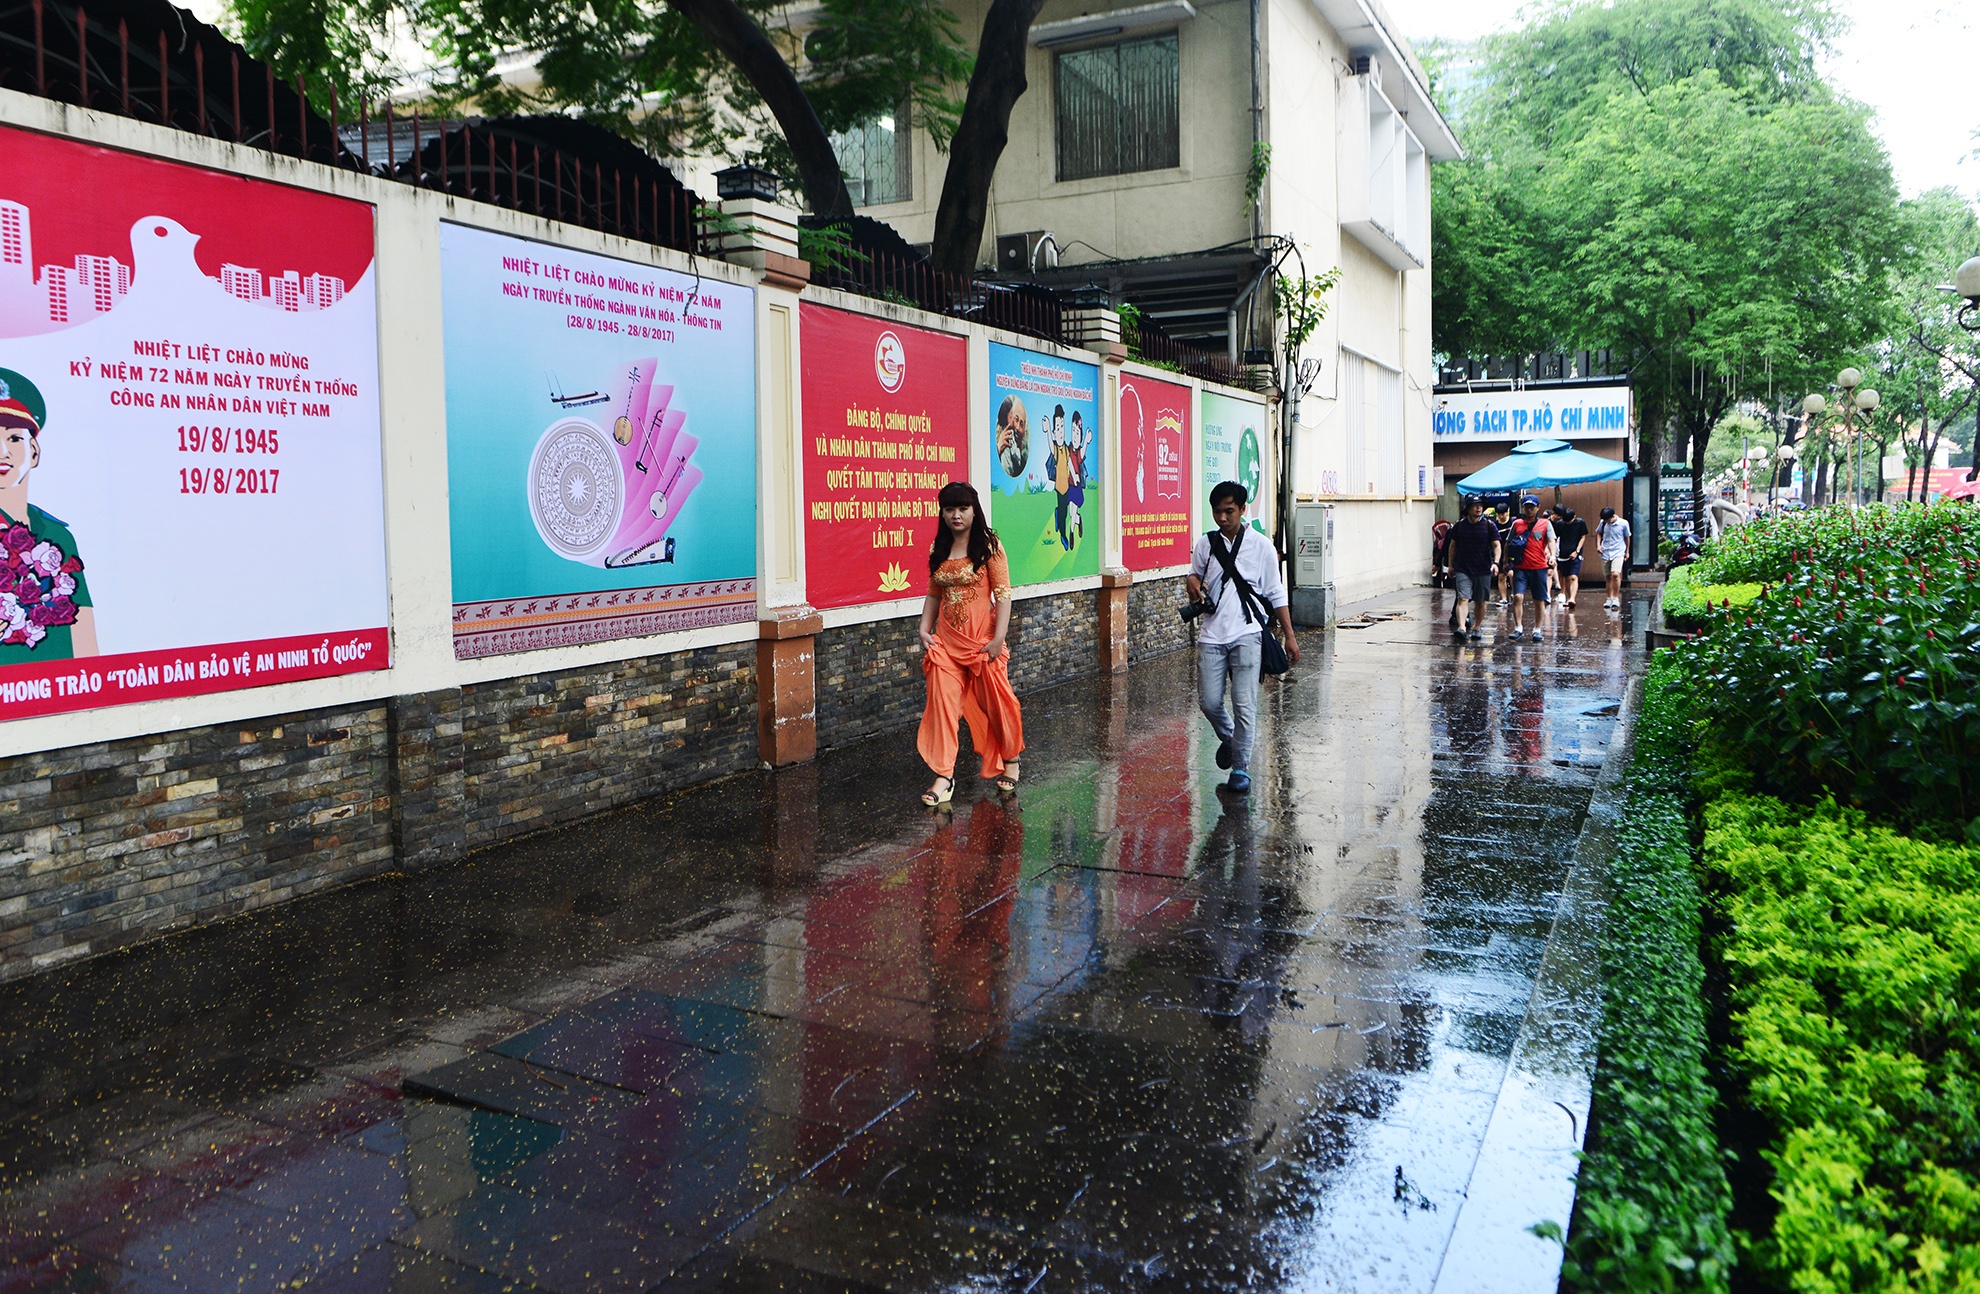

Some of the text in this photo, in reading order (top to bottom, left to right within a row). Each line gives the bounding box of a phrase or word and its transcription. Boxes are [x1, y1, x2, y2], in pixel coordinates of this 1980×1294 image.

[502, 256, 539, 276] NHIỆT
[544, 263, 570, 282] LIỆT
[574, 270, 605, 288] CHÀO
[608, 276, 638, 295] MỪNG
[642, 280, 655, 297] KỶ
[659, 286, 684, 303] NIỆM
[702, 294, 722, 310] NĂM
[502, 281, 529, 299] NGÀY
[533, 287, 571, 306] TRUYỀN
[574, 293, 605, 312] THỐNG
[608, 299, 637, 317] NGÀNH
[639, 304, 656, 320] VĂN
[658, 306, 675, 323] HÓA
[683, 312, 708, 329] THÔNG
[710, 318, 722, 331] TIN
[566, 314, 619, 334] (28/8/1945
[627, 323, 675, 343] 28/8/2017)
[133, 339, 309, 370] NHIỆT LIỆT CHÀO MỪNG
[69, 356, 358, 397] KỶ NIỆM 72 NĂM NGÀY TRUYỀN THỐNG
[110, 388, 330, 417] CÔNG AN NHÂN DÂN VIỆT NAM
[1474, 403, 1507, 433] SÁCH
[1512, 400, 1553, 432] TP.HỒ
[1561, 399, 1583, 430] CHÍ
[1587, 405, 1625, 429] MINH
[846, 402, 932, 435] ĐẢNG BỘ, CHÍNH QUYỀN
[177, 425, 279, 454] 19/8/1945
[815, 433, 956, 463] VÀ NHÂN DÂN THÀNH PHỐ HỒ CHÍ MINH
[1158, 443, 1169, 466] 92
[179, 467, 280, 494] 19/8/2017
[826, 463, 854, 491] QUYẾT
[855, 466, 873, 489] TÂM
[874, 469, 894, 492] THỰC
[895, 468, 913, 492] HIỆN
[914, 466, 936, 489] THẮNG
[811, 501, 832, 524] NGHỊ
[833, 495, 860, 522] QUYẾT
[861, 501, 876, 522] ĐẠI
[877, 496, 890, 522] HỘI
[891, 495, 912, 518] ĐẢNG
[912, 497, 923, 520] BỘ
[872, 524, 914, 548] LẦN THỨ X
[55, 669, 102, 697] TRÀO
[107, 664, 160, 690] “TOÀN
[163, 659, 196, 683] DÂN
[199, 653, 230, 680] BẢO
[233, 651, 251, 677] VỆ
[256, 653, 275, 672] AN
[278, 648, 309, 670] NINH
[312, 639, 330, 665] TỔ
[333, 640, 373, 664] QUỐC”
